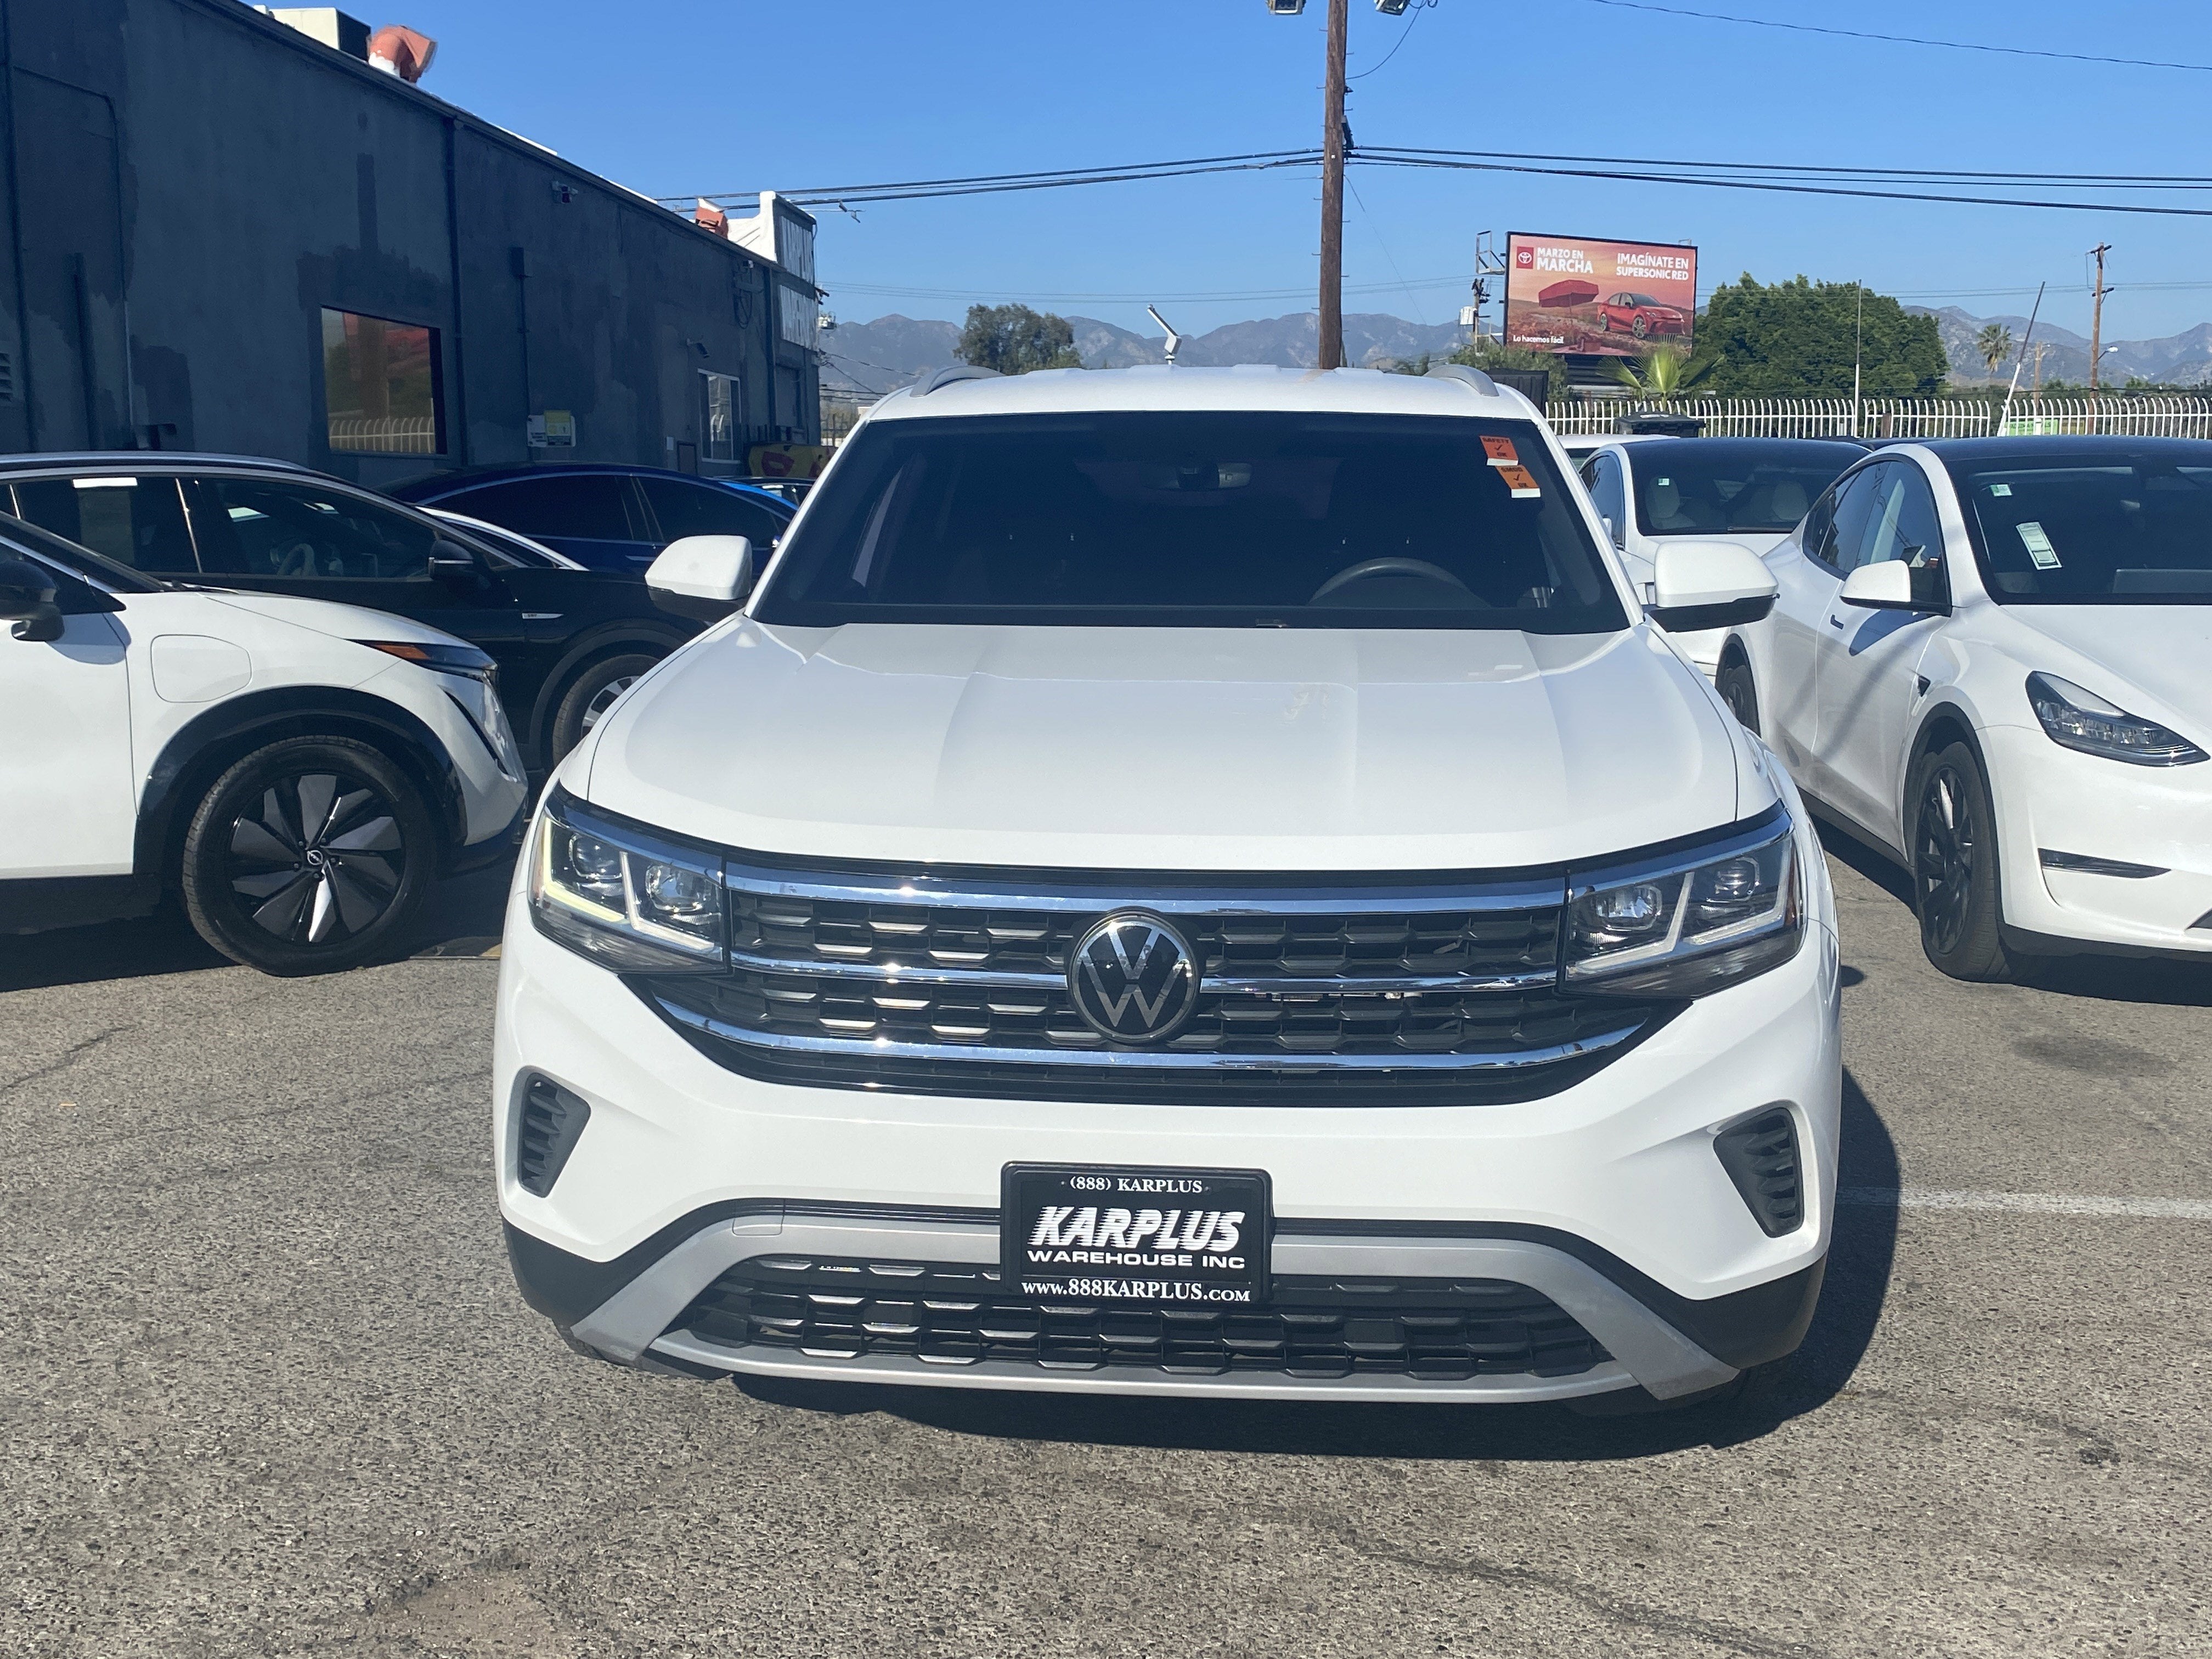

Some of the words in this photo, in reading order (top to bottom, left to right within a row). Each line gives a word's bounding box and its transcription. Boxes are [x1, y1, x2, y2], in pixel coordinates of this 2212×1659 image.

[1537, 247, 1570, 258] MARZO
[1572, 250, 1584, 259] EN
[1617, 252, 1673, 268] IMAGÍNATE
[1675, 258, 1689, 269] EN
[1537, 257, 1594, 274] MARCHA
[1616, 267, 1671, 279] SUPERSONIC
[1672, 270, 1689, 281] RED
[1522, 335, 1549, 343] hacemos
[1070, 1176, 1111, 1191] (888)
[1118, 1178, 1203, 1193] KARPLUS
[1027, 1206, 1246, 1252] KARPLUS
[1027, 1250, 1193, 1267] WAREHOUSE
[1202, 1255, 1245, 1269] INC
